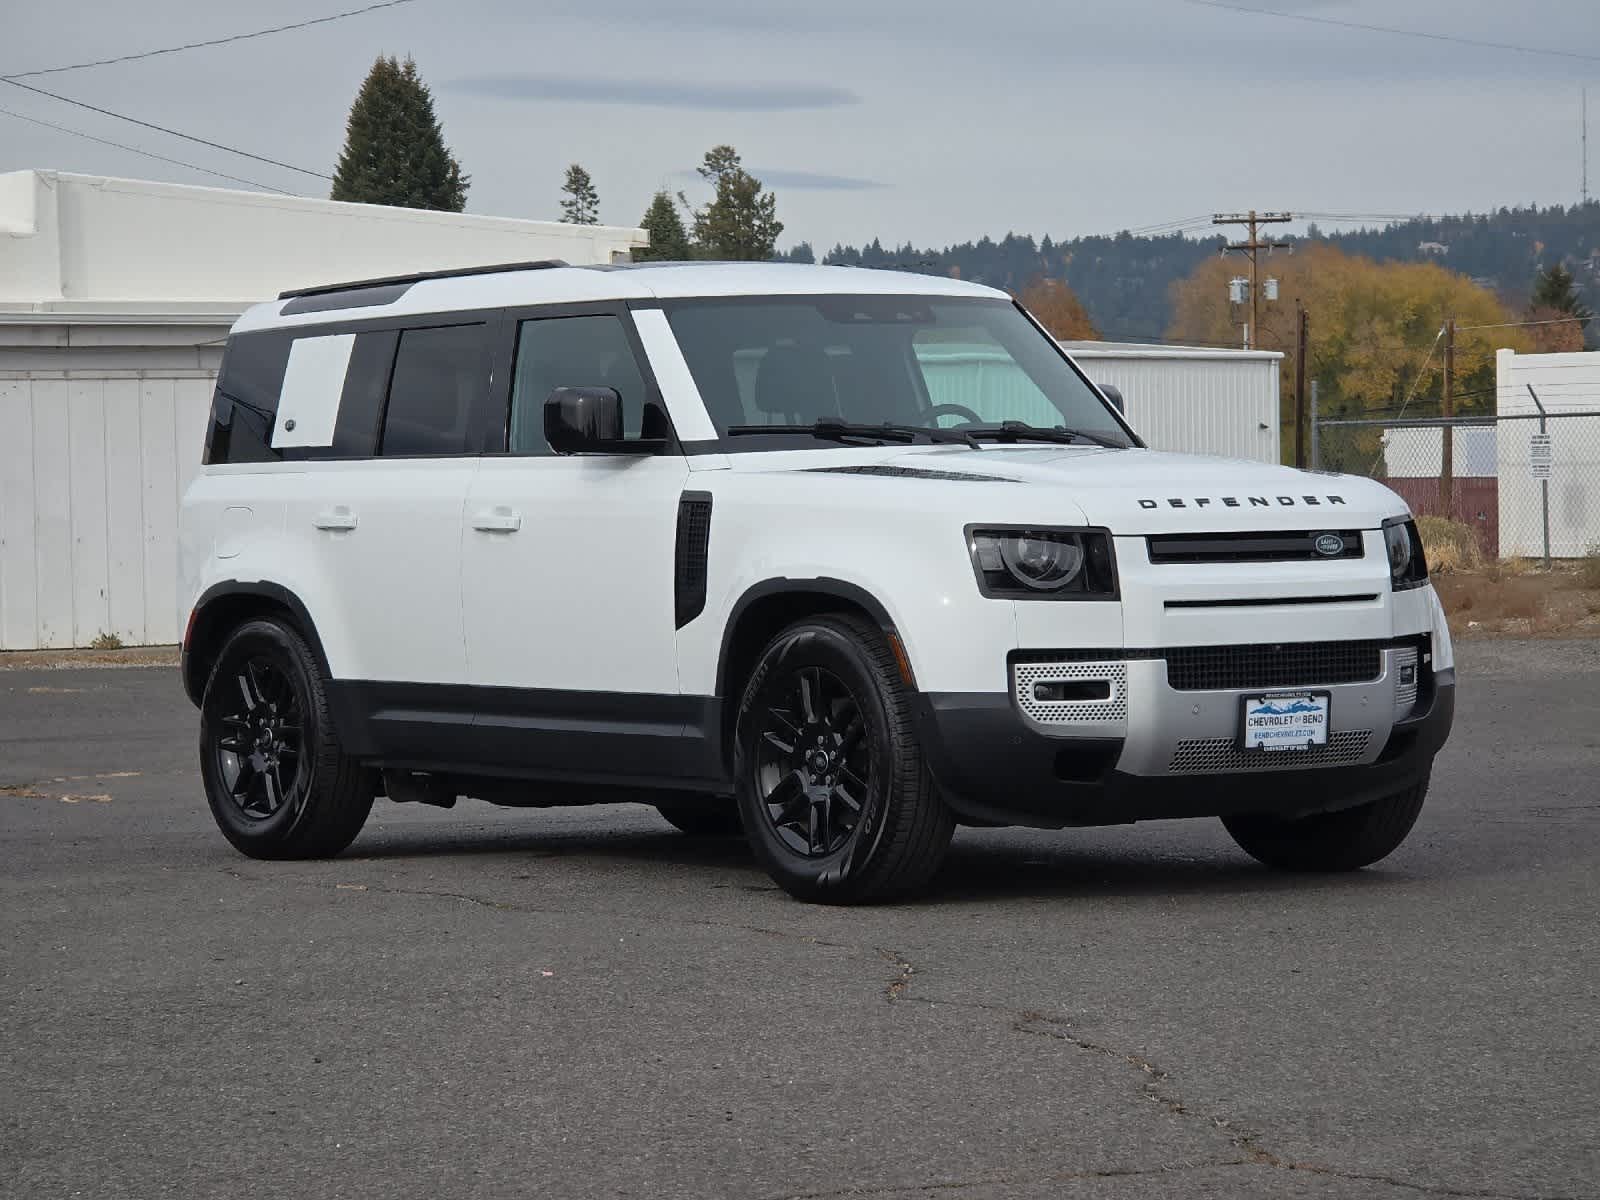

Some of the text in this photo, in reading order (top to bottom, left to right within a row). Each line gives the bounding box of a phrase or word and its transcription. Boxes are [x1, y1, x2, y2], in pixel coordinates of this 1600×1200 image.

[1137, 495, 1347, 509] DEFENDER
[1248, 715, 1293, 727] CHEVROLET
[1302, 714, 1324, 724] BEND
